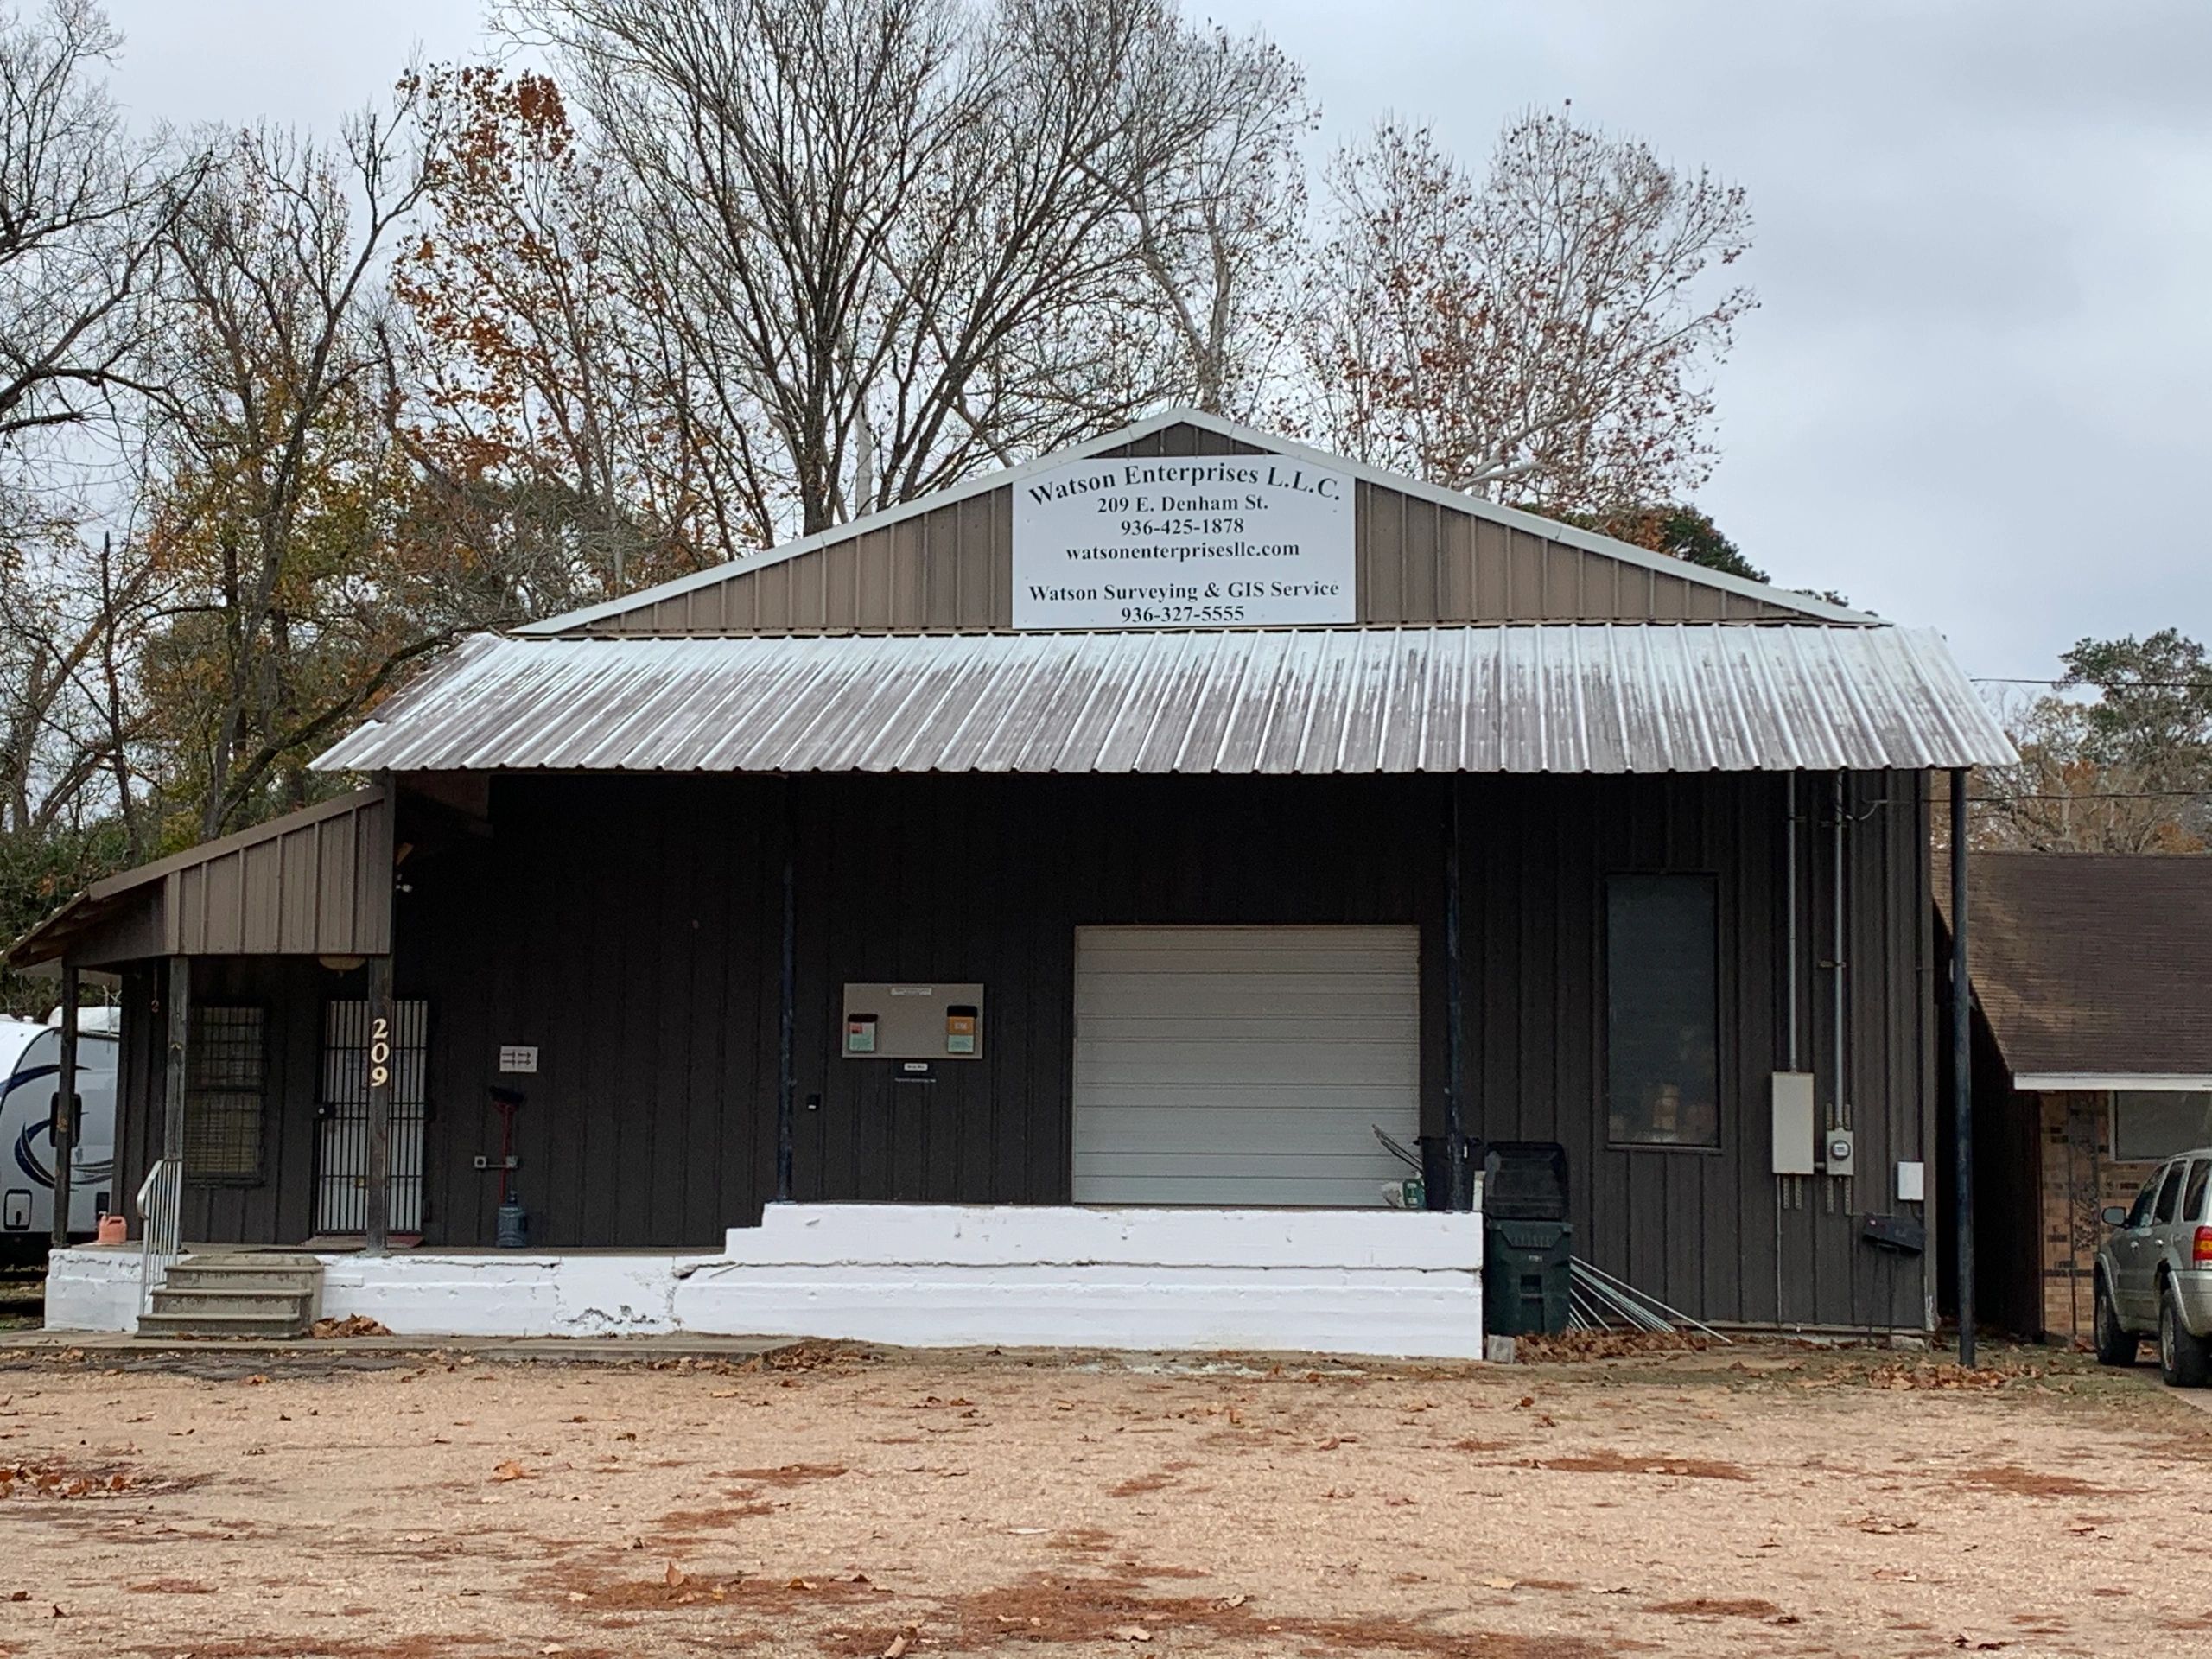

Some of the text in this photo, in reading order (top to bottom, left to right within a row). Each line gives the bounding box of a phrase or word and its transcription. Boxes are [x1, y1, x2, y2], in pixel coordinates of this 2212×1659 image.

[1028, 462, 1340, 506] Watson Enterprises L.L.C.
[1097, 494, 1269, 513] 209 E. Denham St.
[1121, 518, 1244, 536] 936-425-1878
[1066, 542, 1300, 563] watsonenterprisesllc.com
[1029, 581, 1340, 603] Watson Surveying & GIS Service
[1121, 605, 1245, 623] 936-327-5555
[371, 1018, 389, 1087] 209
